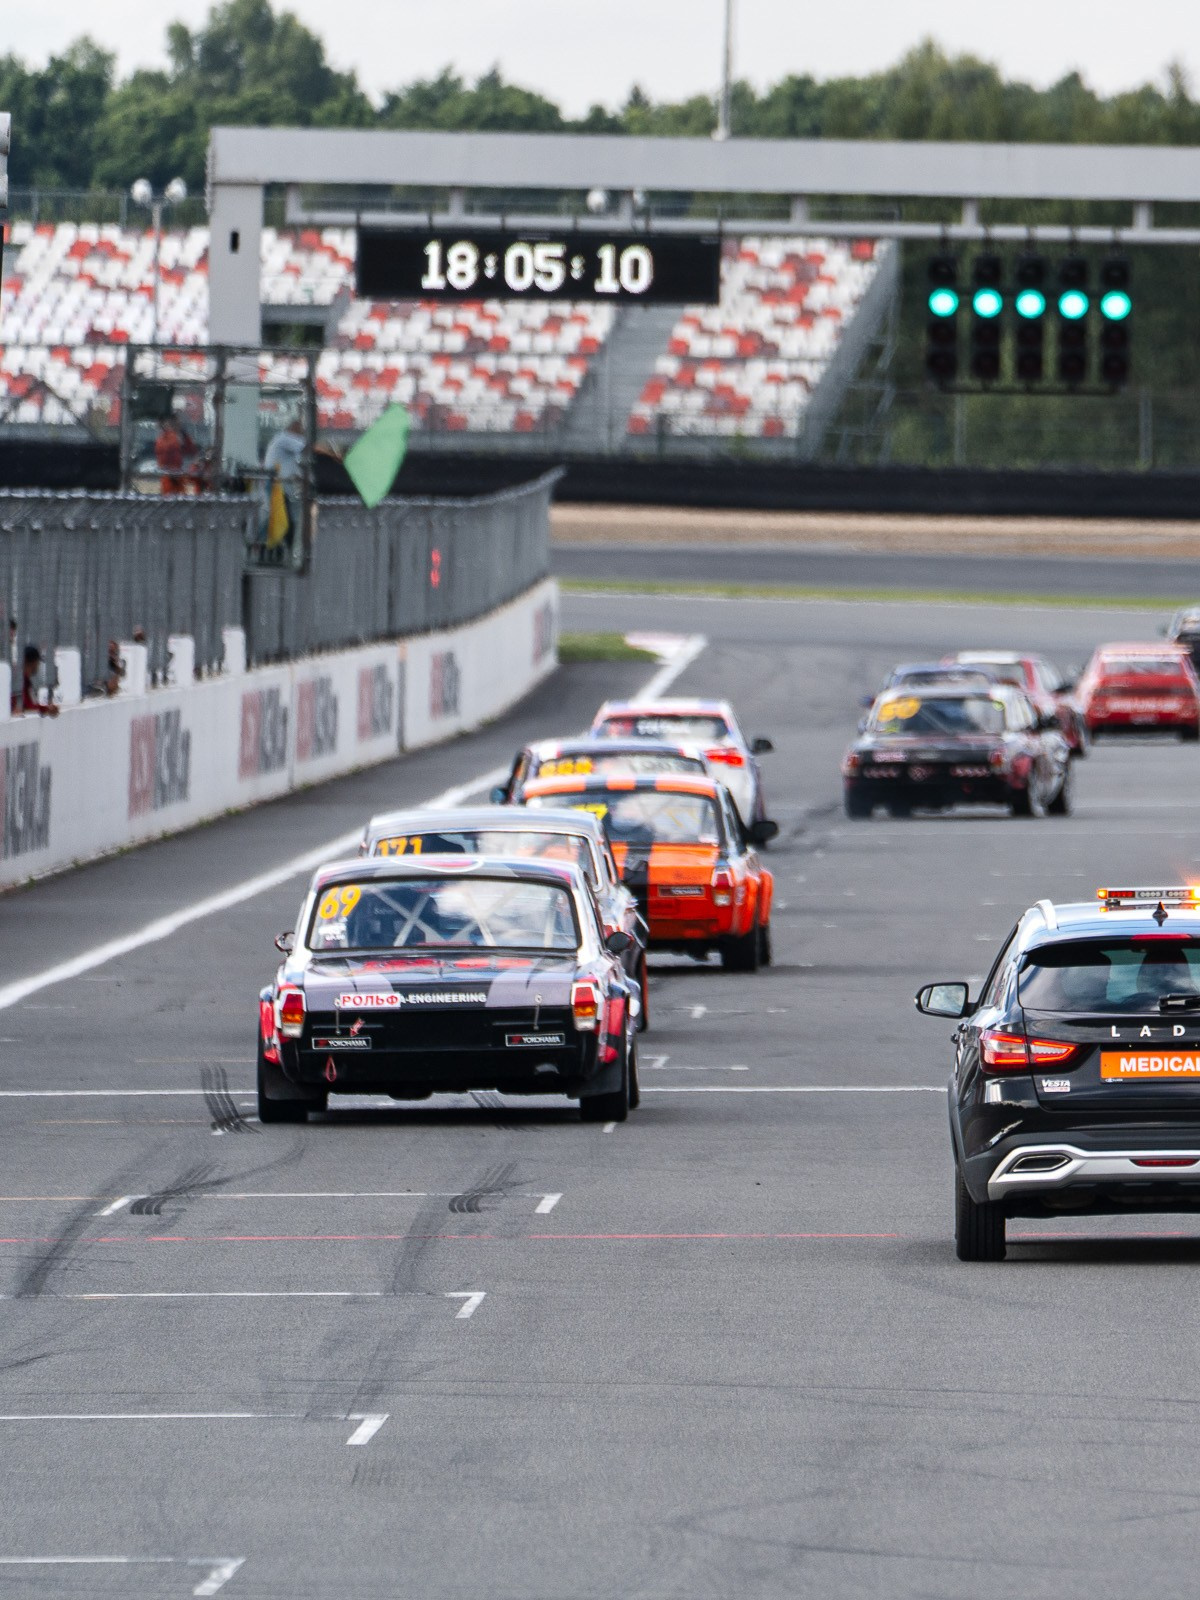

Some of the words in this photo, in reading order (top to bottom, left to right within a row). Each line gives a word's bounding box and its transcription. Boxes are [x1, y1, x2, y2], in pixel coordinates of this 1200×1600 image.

[421, 239, 654, 294] 18:05:10
[377, 835, 423, 856] 171
[319, 884, 362, 920] 69
[341, 994, 400, 1007] РОЛЬФ
[328, 1039, 368, 1048] YOKOHAMA
[522, 1036, 561, 1045] YOKOHAMA
[1041, 1078, 1071, 1087] VESTA
